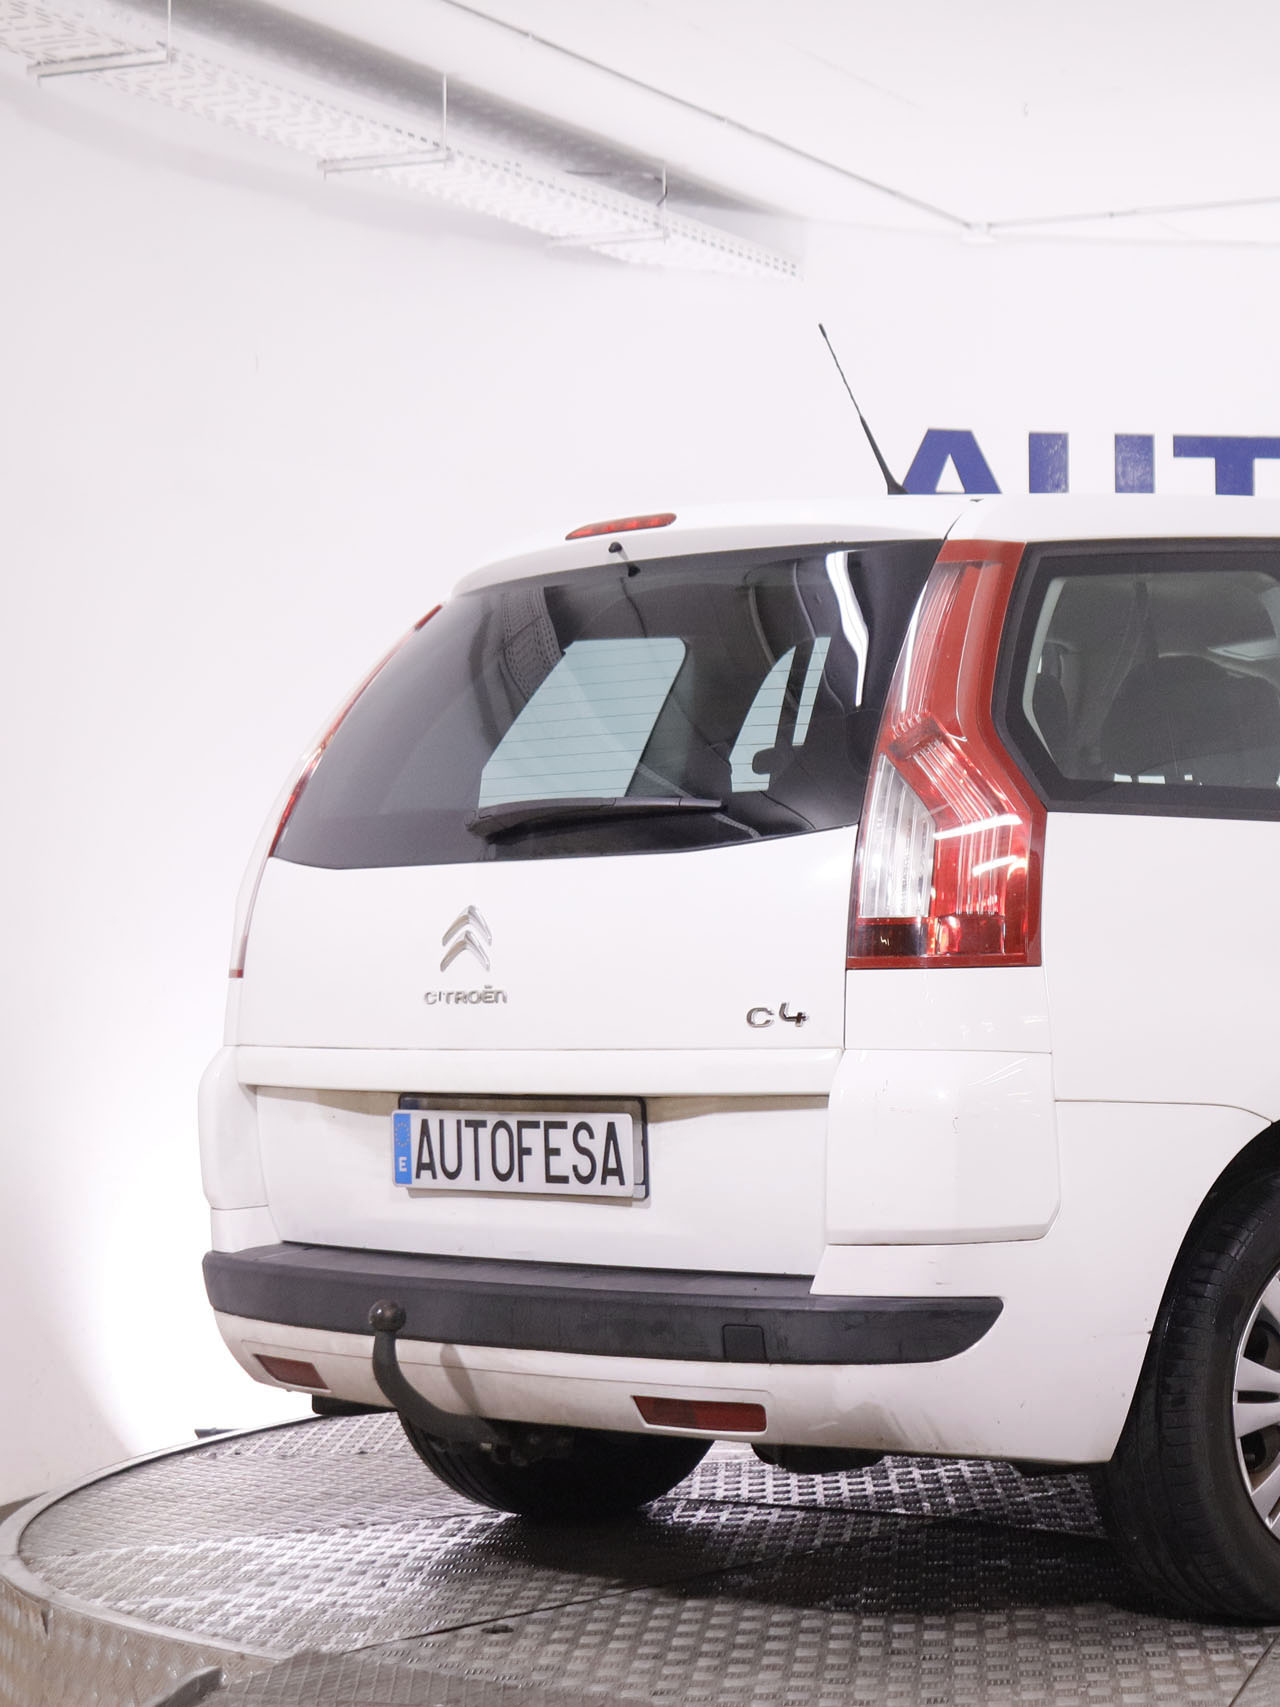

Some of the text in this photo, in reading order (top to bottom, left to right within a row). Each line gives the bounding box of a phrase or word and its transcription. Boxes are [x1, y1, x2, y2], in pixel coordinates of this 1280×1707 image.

[746, 1003, 808, 1028] C4
[398, 1156, 408, 1172] E
[415, 1118, 625, 1186] AUTOFESA
